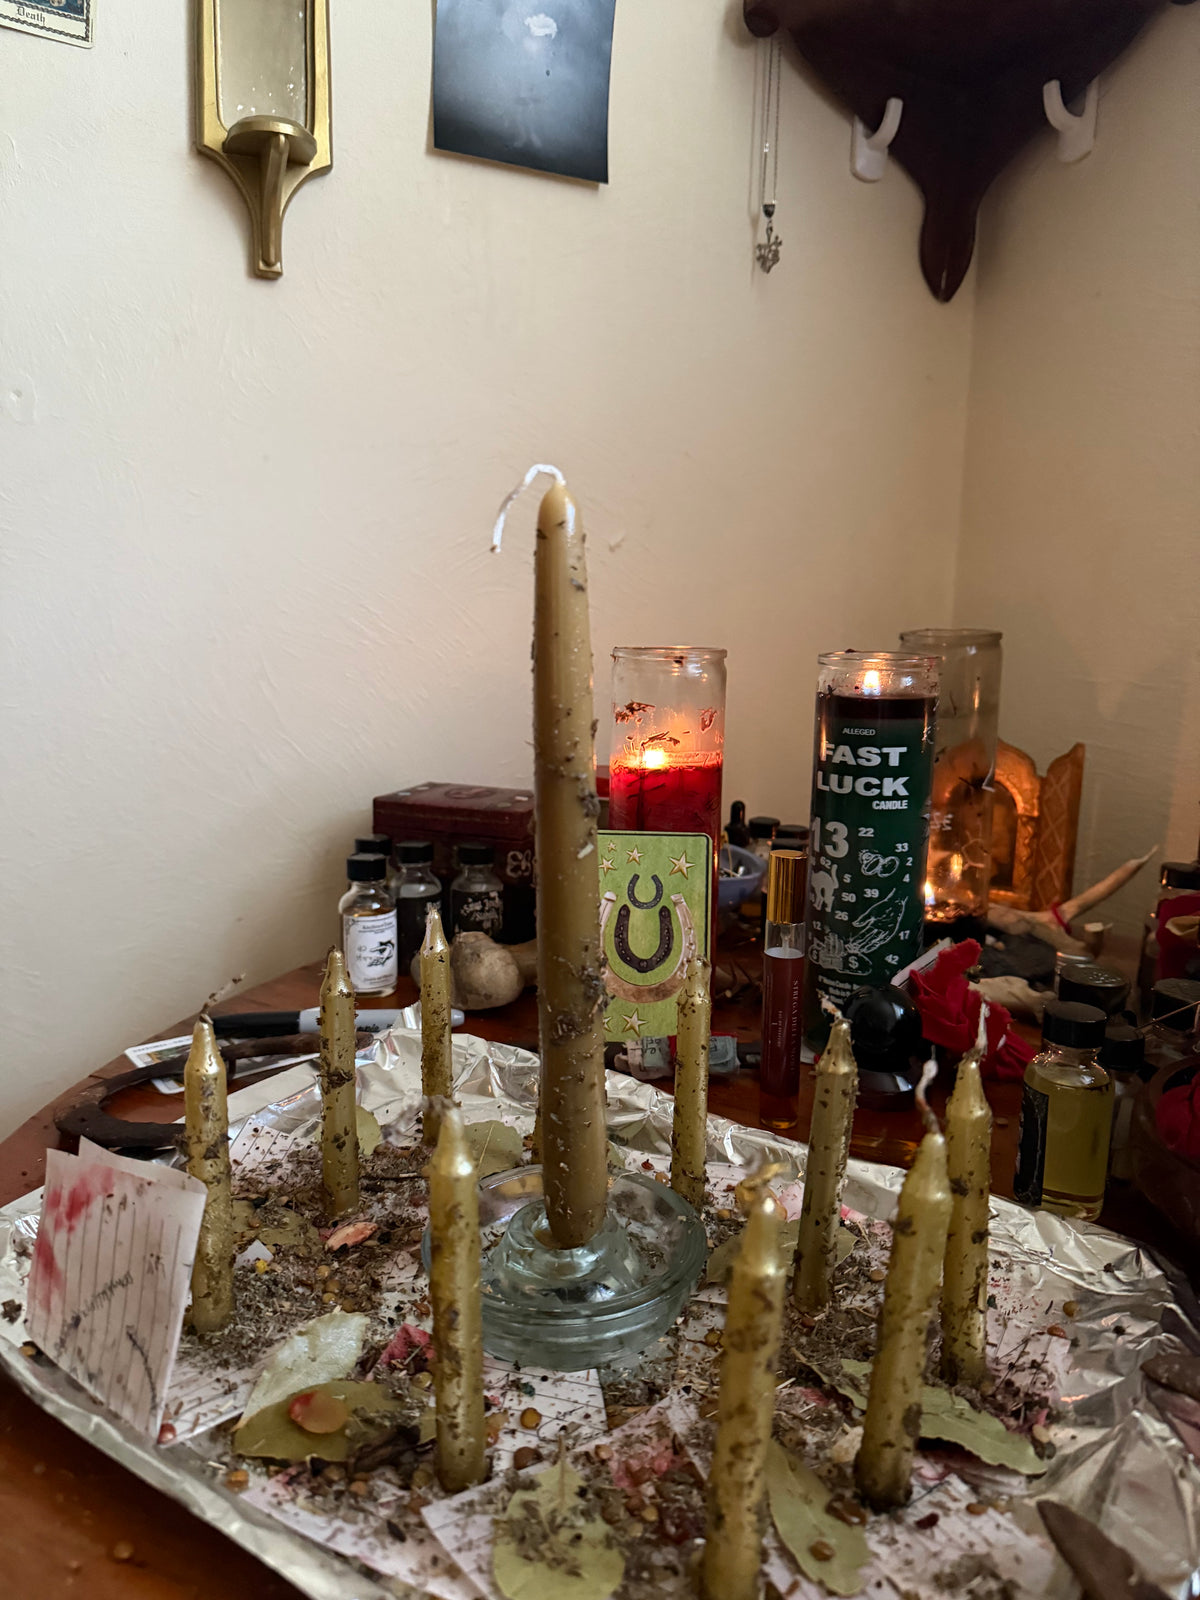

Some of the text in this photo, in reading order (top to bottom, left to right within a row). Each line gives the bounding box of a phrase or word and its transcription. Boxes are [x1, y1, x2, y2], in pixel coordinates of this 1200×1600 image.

[16, 5, 46, 26] Death
[842, 727, 876, 736] ALLEGED
[821, 741, 908, 767] FAST
[817, 770, 910, 797] LUCK
[872, 799, 908, 810] CANDLE
[811, 816, 849, 859] 13
[858, 827, 875, 838] 22
[895, 842, 909, 853] 33
[905, 856, 914, 867] 2
[843, 873, 852, 884] 5
[902, 873, 911, 883] 4
[841, 892, 857, 903] 50
[863, 888, 880, 898] 39
[834, 910, 849, 921] 26
[812, 920, 821, 930] 12
[898, 929, 910, 941] 17
[884, 953, 900, 965] 42
